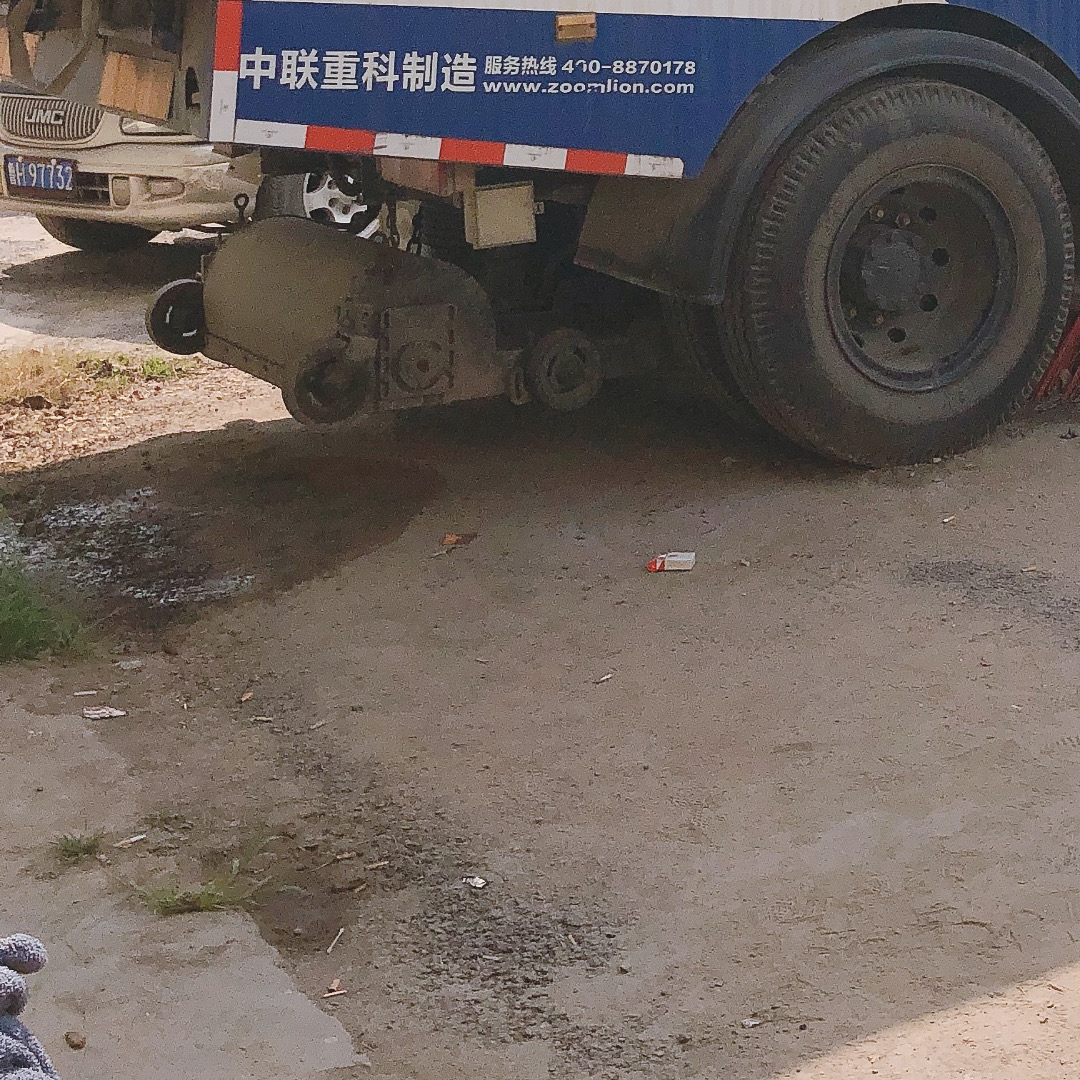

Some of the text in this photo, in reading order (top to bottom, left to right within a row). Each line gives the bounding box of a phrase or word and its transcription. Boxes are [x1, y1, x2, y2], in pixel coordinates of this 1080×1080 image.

[239, 46, 477, 93] 中联重科制造
[484, 55, 557, 76] 服务热线
[25, 107, 65, 124] JMC
